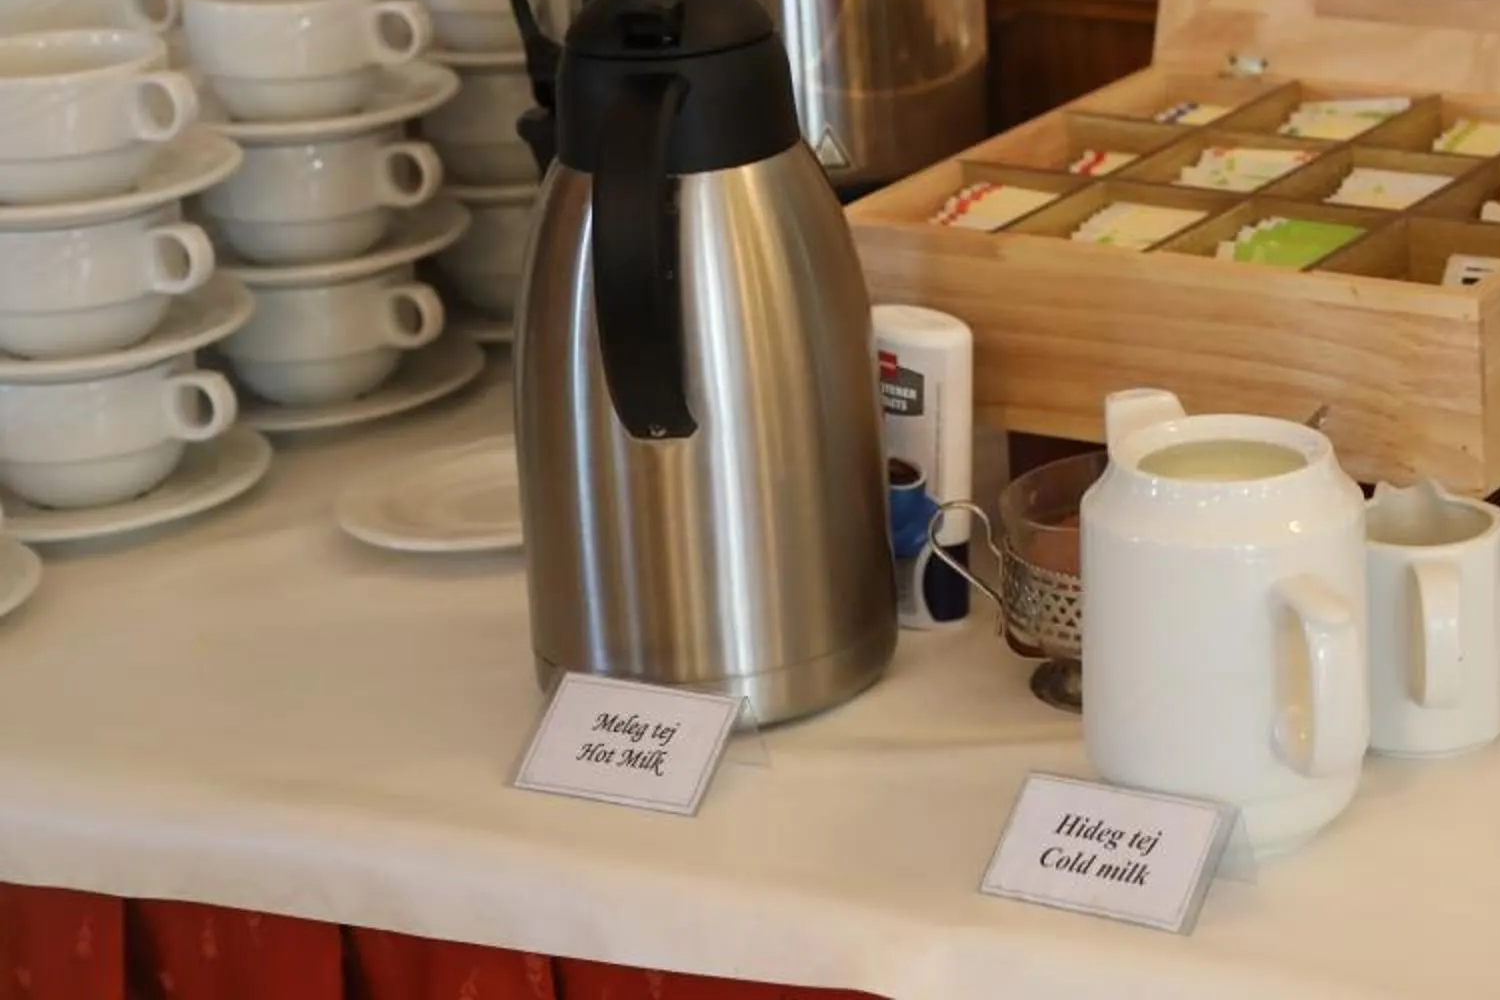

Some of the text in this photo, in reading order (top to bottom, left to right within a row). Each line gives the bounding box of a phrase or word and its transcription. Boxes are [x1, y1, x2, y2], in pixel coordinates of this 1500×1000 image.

[592, 712, 681, 746] Meleg tej
[576, 743, 667, 776] Hot Milk
[1055, 813, 1163, 857] Hideg tej
[1039, 846, 1151, 886] Cold milk
